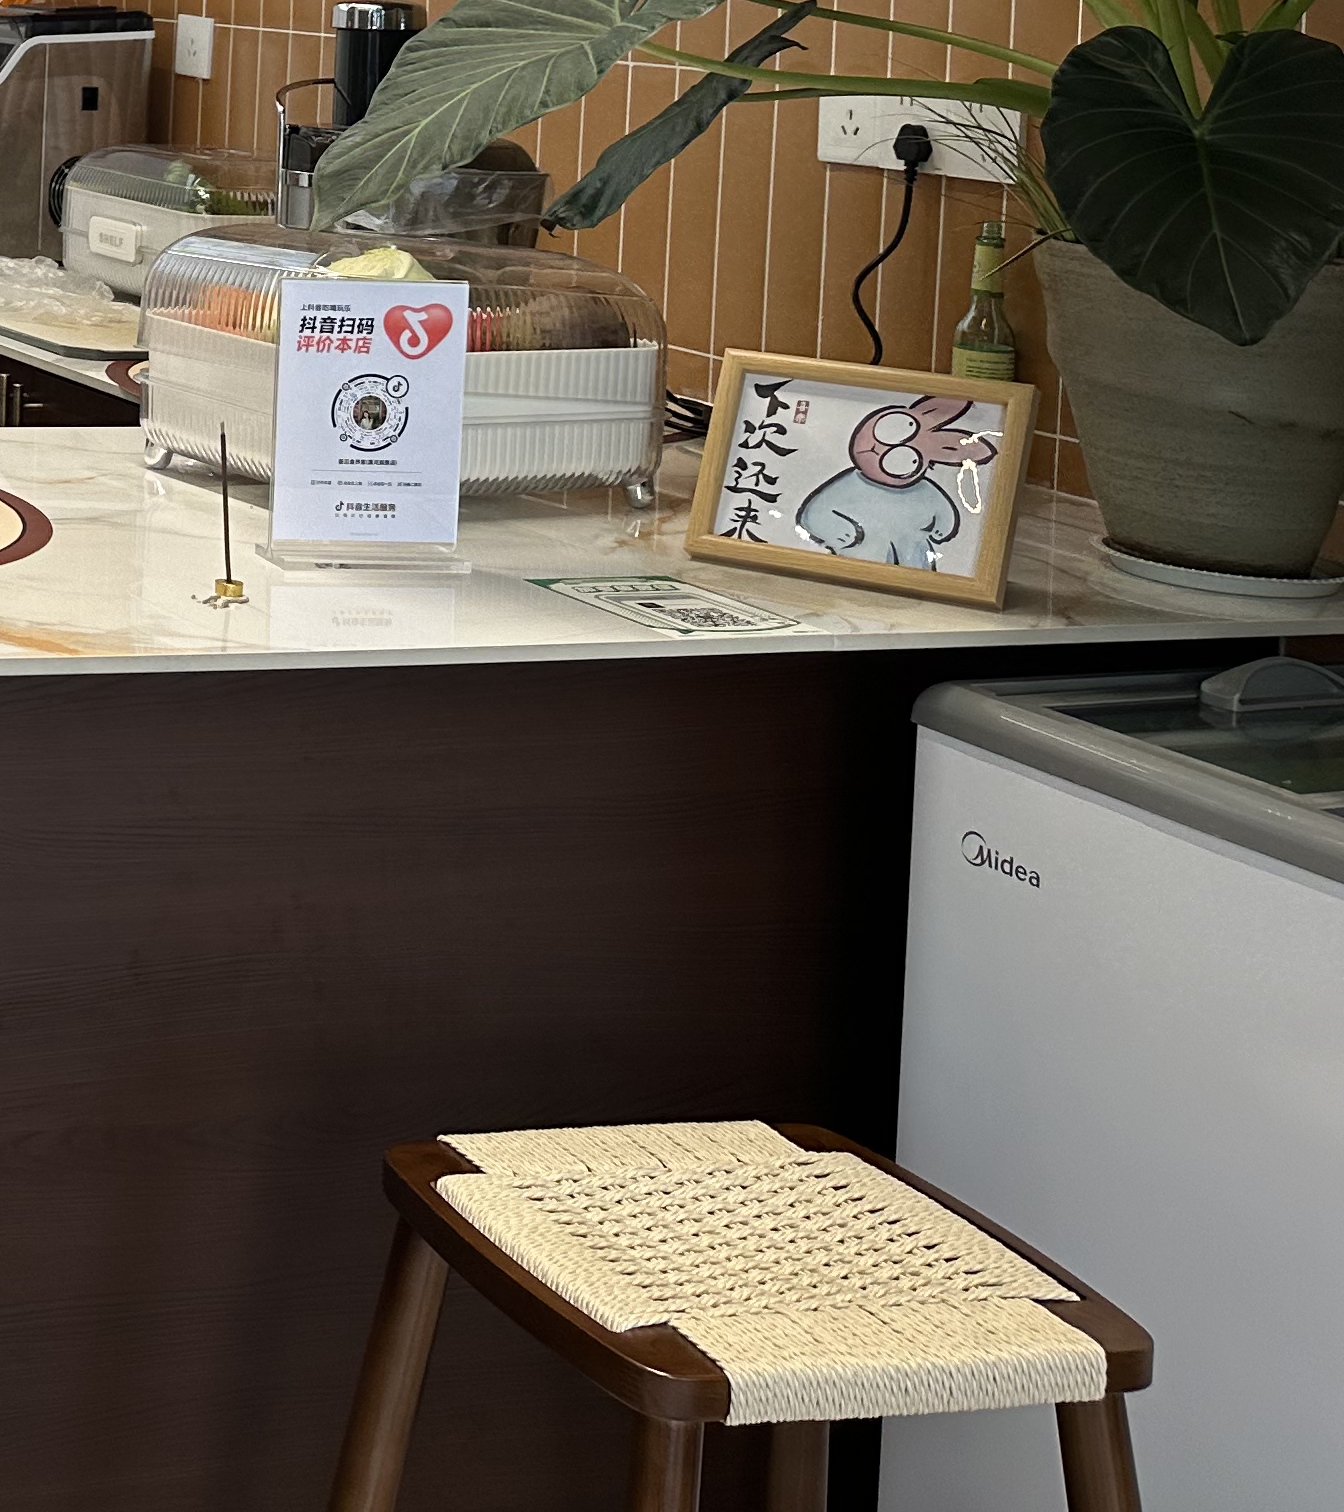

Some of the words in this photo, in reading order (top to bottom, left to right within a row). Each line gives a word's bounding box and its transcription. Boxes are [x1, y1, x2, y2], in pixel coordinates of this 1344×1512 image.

[296, 335, 373, 355] 评价本店
[298, 316, 375, 335] 抖音扫码
[720, 378, 799, 544] 下次还来
[961, 830, 1041, 889] Midea
